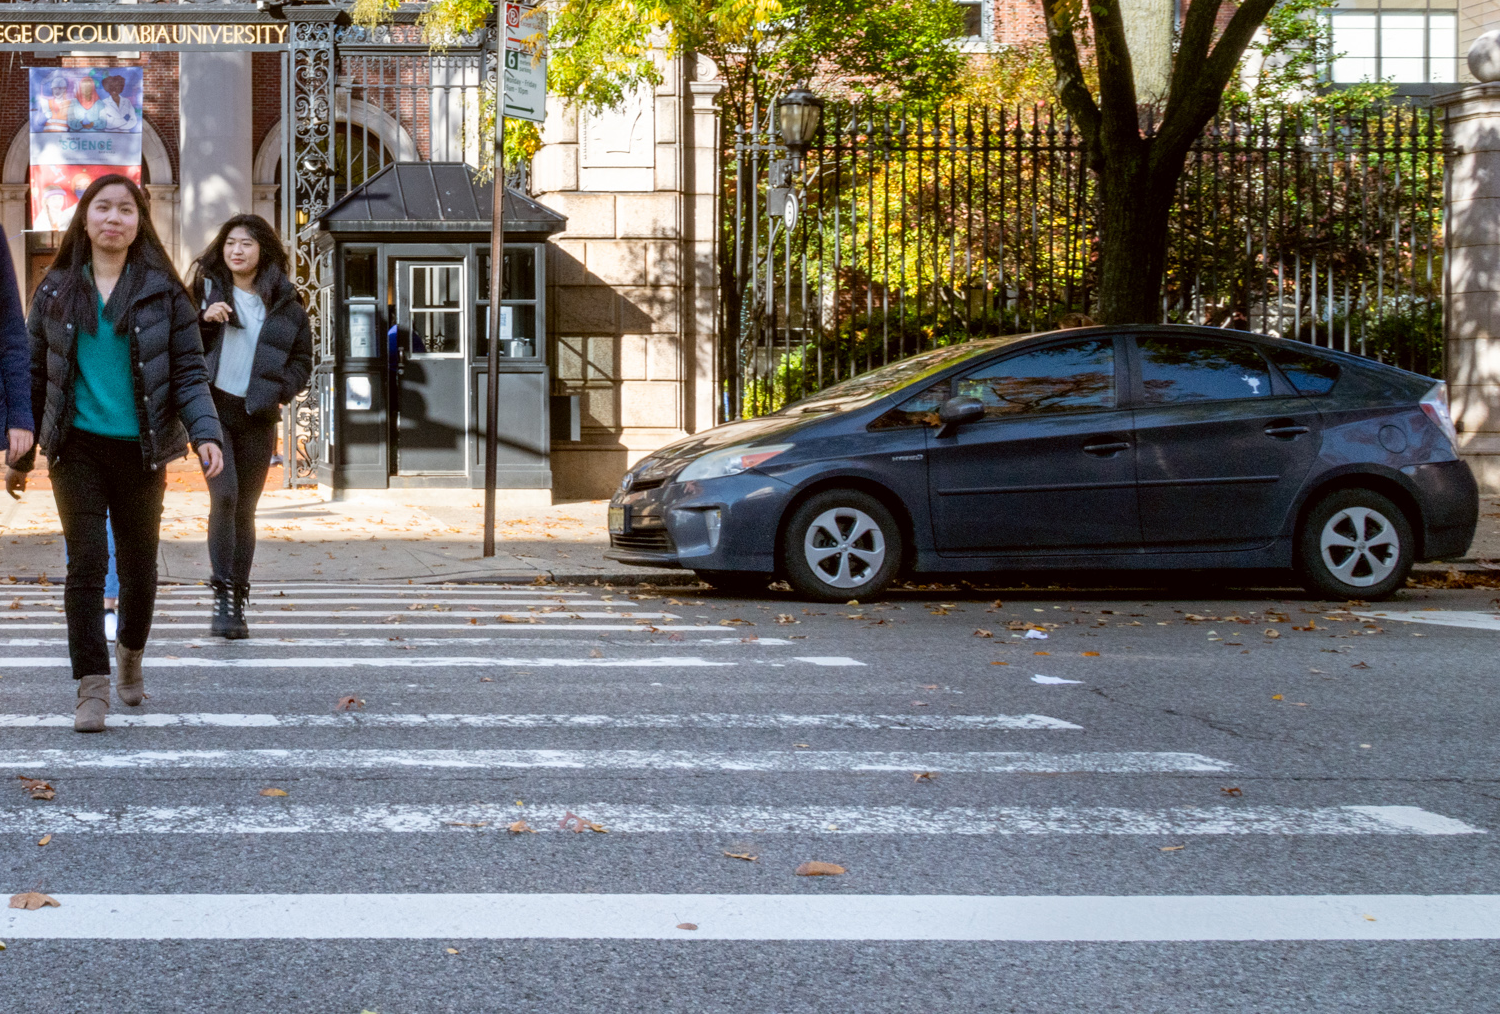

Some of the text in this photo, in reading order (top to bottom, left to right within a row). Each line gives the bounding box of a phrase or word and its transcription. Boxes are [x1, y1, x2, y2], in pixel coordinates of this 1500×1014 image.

[35, 23, 64, 44] OF
[66, 24, 171, 44] COLUMBIA
[172, 24, 288, 44] UNIVERSITY
[508, 52, 516, 68] 6
